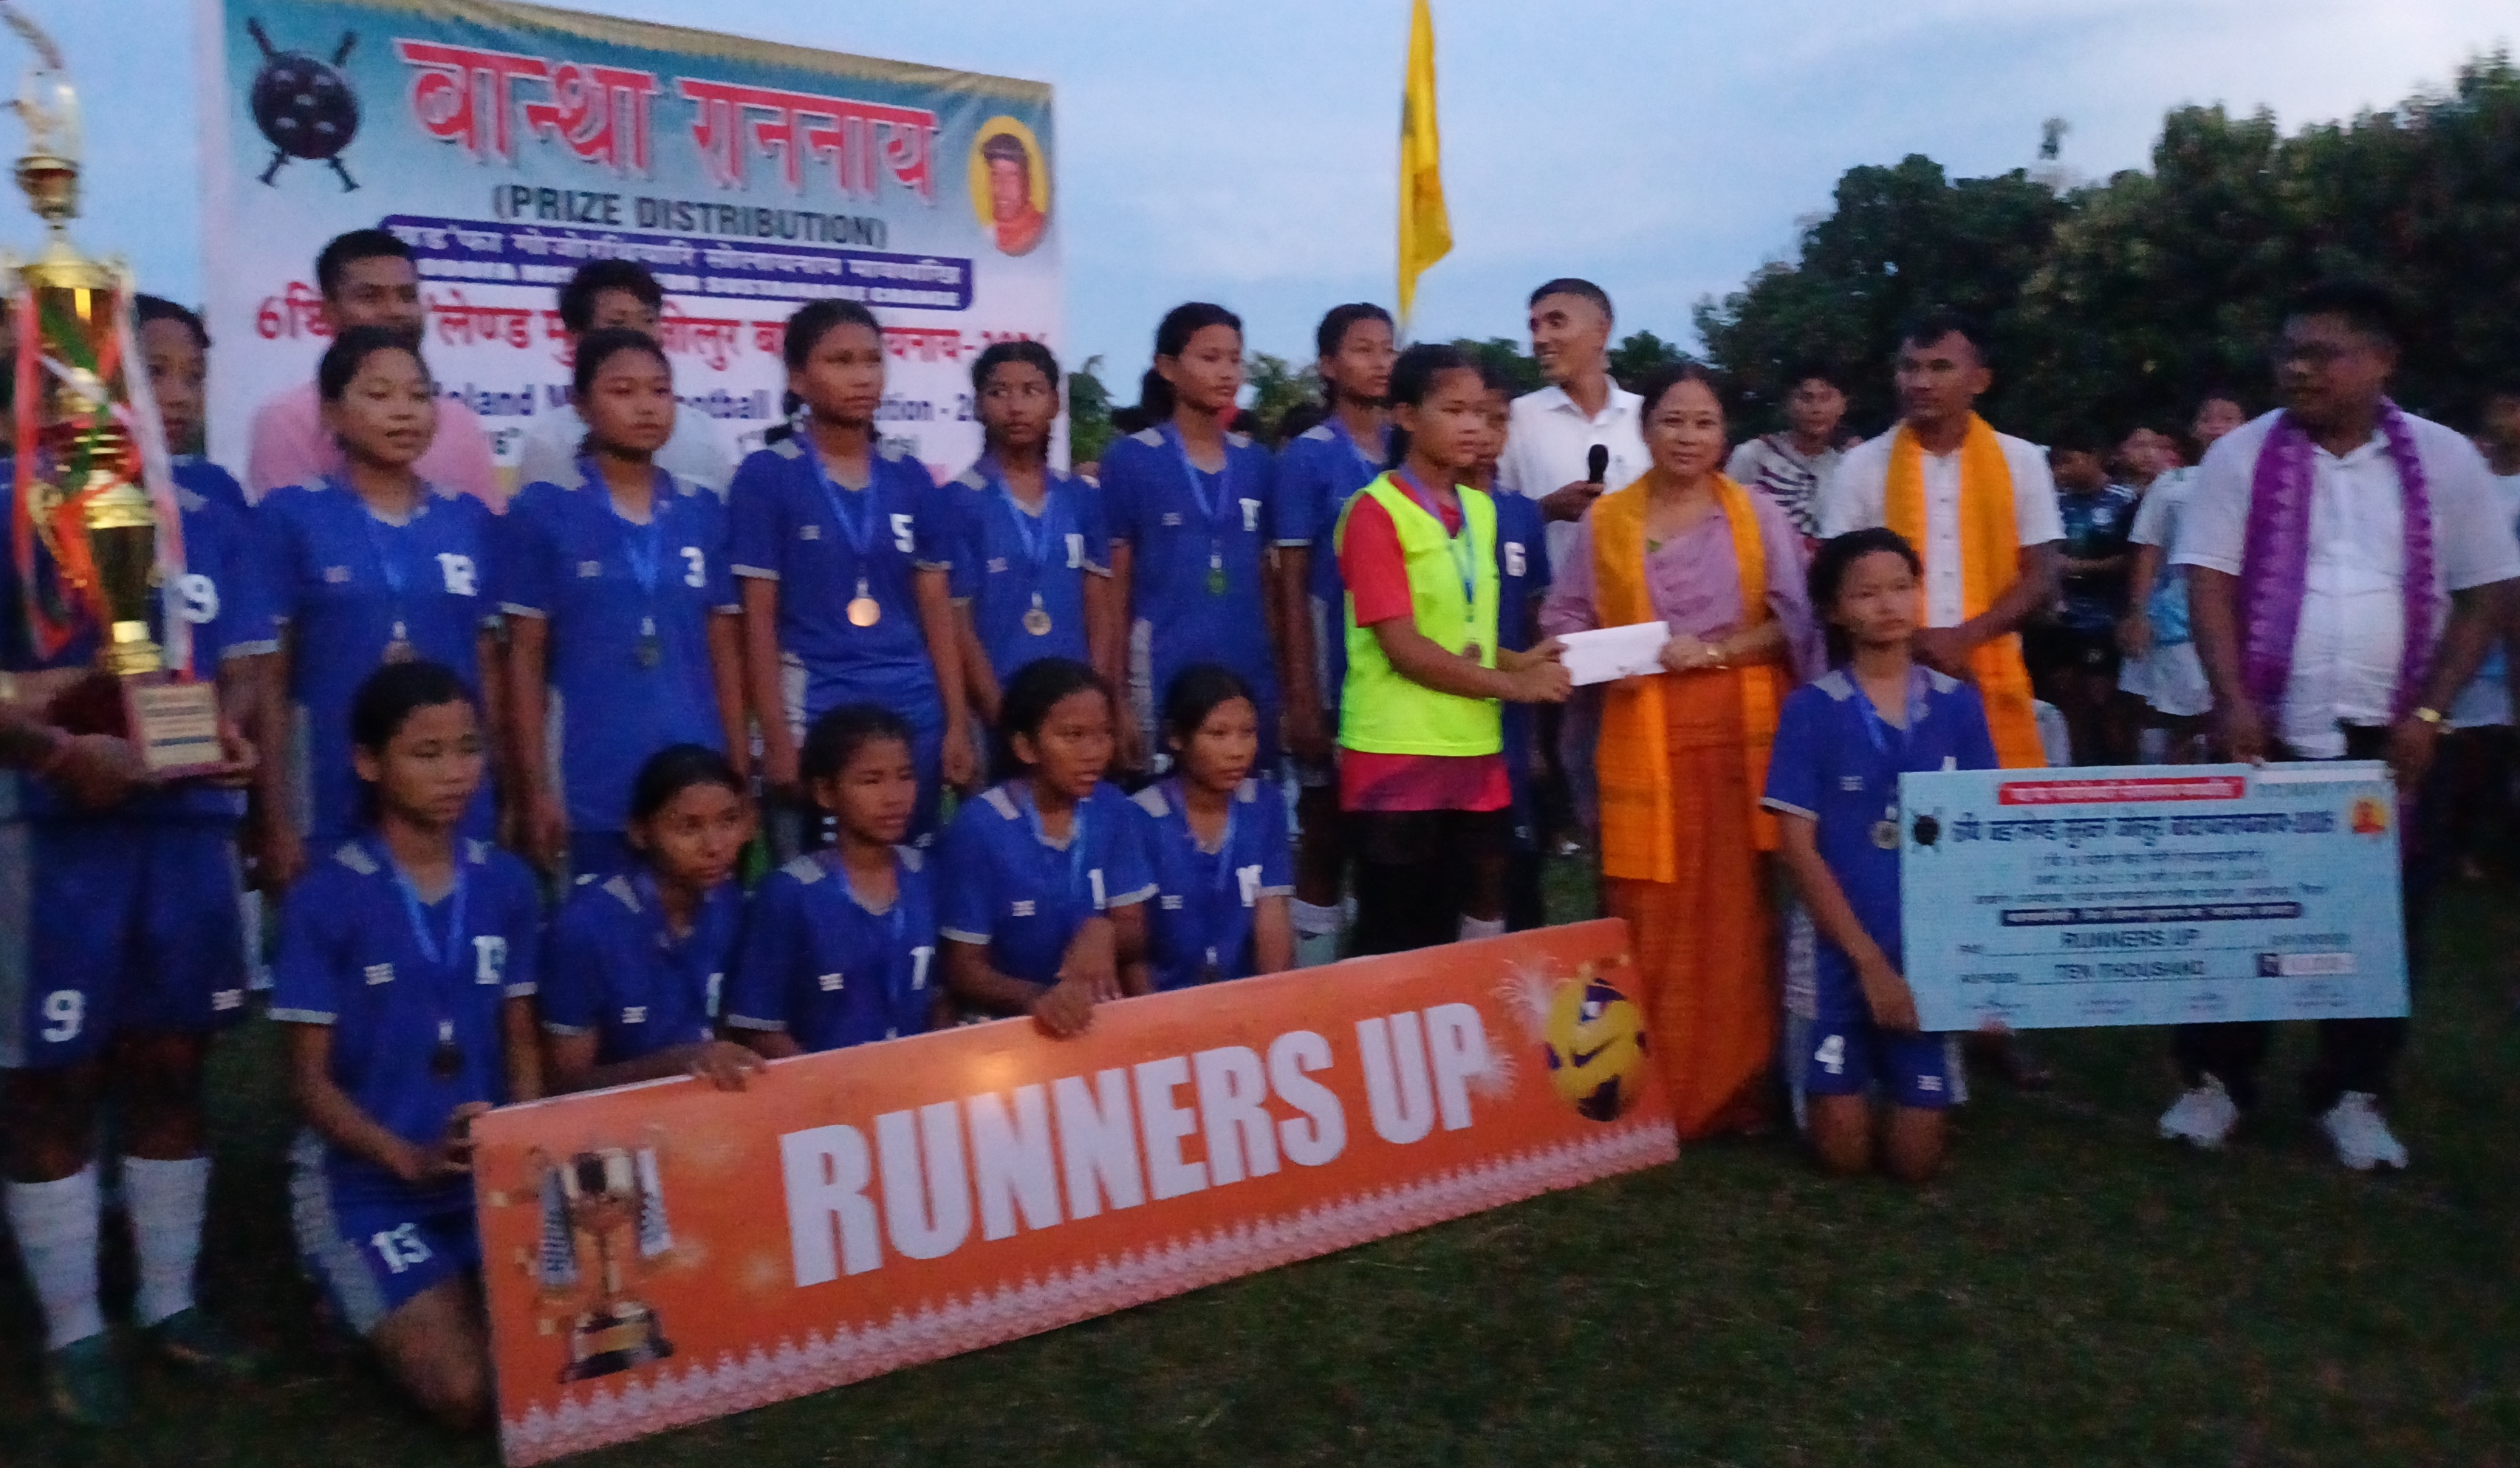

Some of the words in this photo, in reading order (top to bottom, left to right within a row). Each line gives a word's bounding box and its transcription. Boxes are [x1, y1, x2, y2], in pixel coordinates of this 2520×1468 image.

[493, 184, 620, 225] (PRIZE
[634, 197, 888, 249] DISTRIBUTION)
[889, 513, 914, 553] 5
[680, 546, 705, 587] 3
[41, 989, 85, 1043] 9
[780, 1030, 1346, 1288] RUNNERS
[1355, 1003, 1486, 1145] UP
